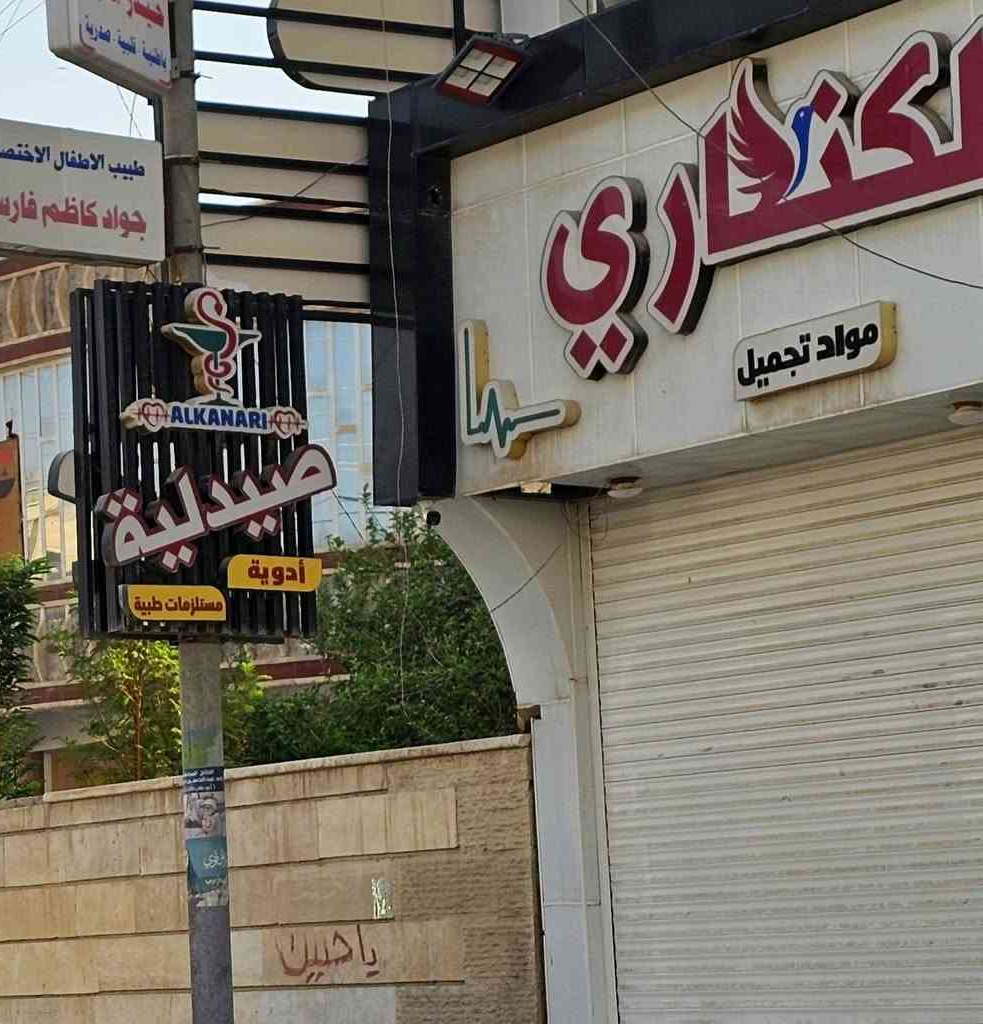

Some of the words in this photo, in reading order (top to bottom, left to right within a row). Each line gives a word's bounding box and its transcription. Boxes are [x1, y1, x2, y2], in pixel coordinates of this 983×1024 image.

[54, 150, 104, 171] الاطفال
[108, 160, 145, 181] طبيب
[42, 197, 98, 229] كاظم
[102, 205, 147, 241] جواد
[816, 323, 879, 360] مواد
[737, 333, 811, 388] تجميل
[170, 405, 267, 430] ALKANARI
[112, 446, 335, 572] صيدلية
[247, 559, 306, 586] أدوية
[134, 596, 162, 616] طبية
[165, 596, 223, 616] مستلزمات
